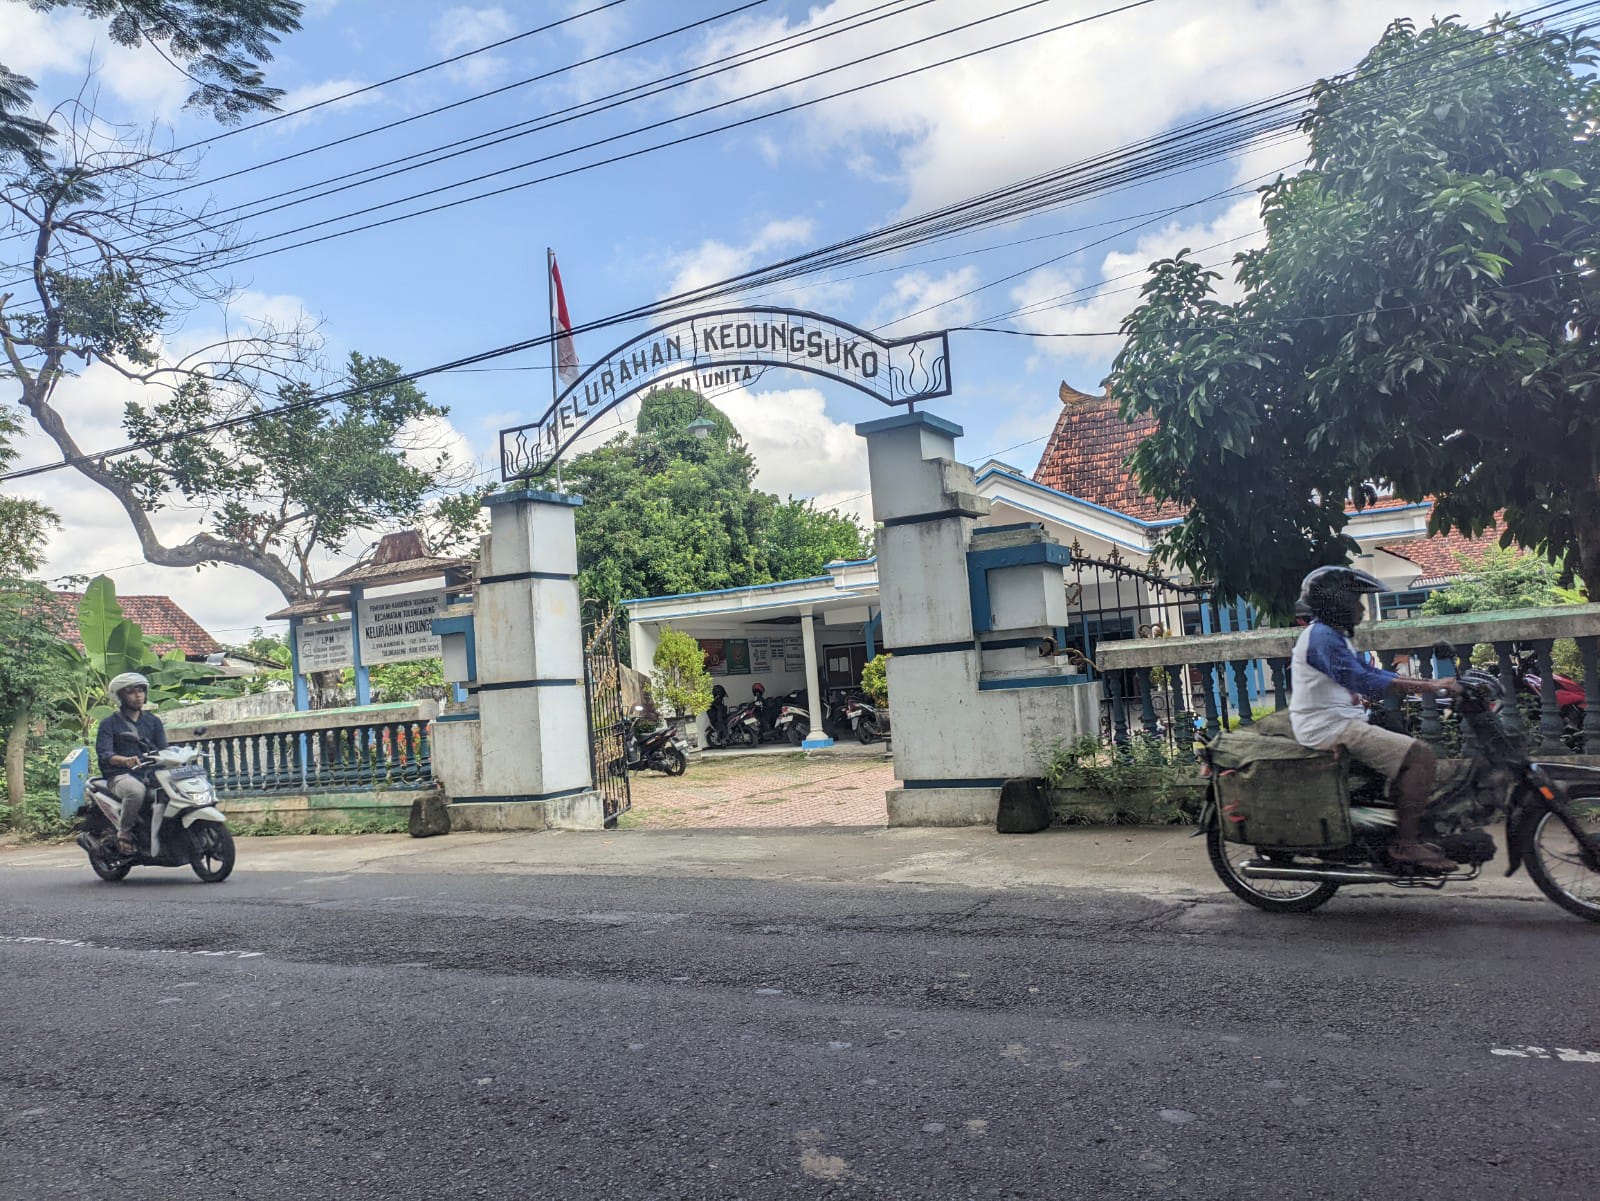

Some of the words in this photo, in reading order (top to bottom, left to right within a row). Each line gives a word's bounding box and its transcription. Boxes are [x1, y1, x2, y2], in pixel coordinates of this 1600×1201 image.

[546, 335, 682, 445] KELURAHAN
[703, 322, 879, 378] KEDUNGSUKO
[702, 365, 752, 389] UNITA
[365, 622, 403, 640] KELURAHAN
